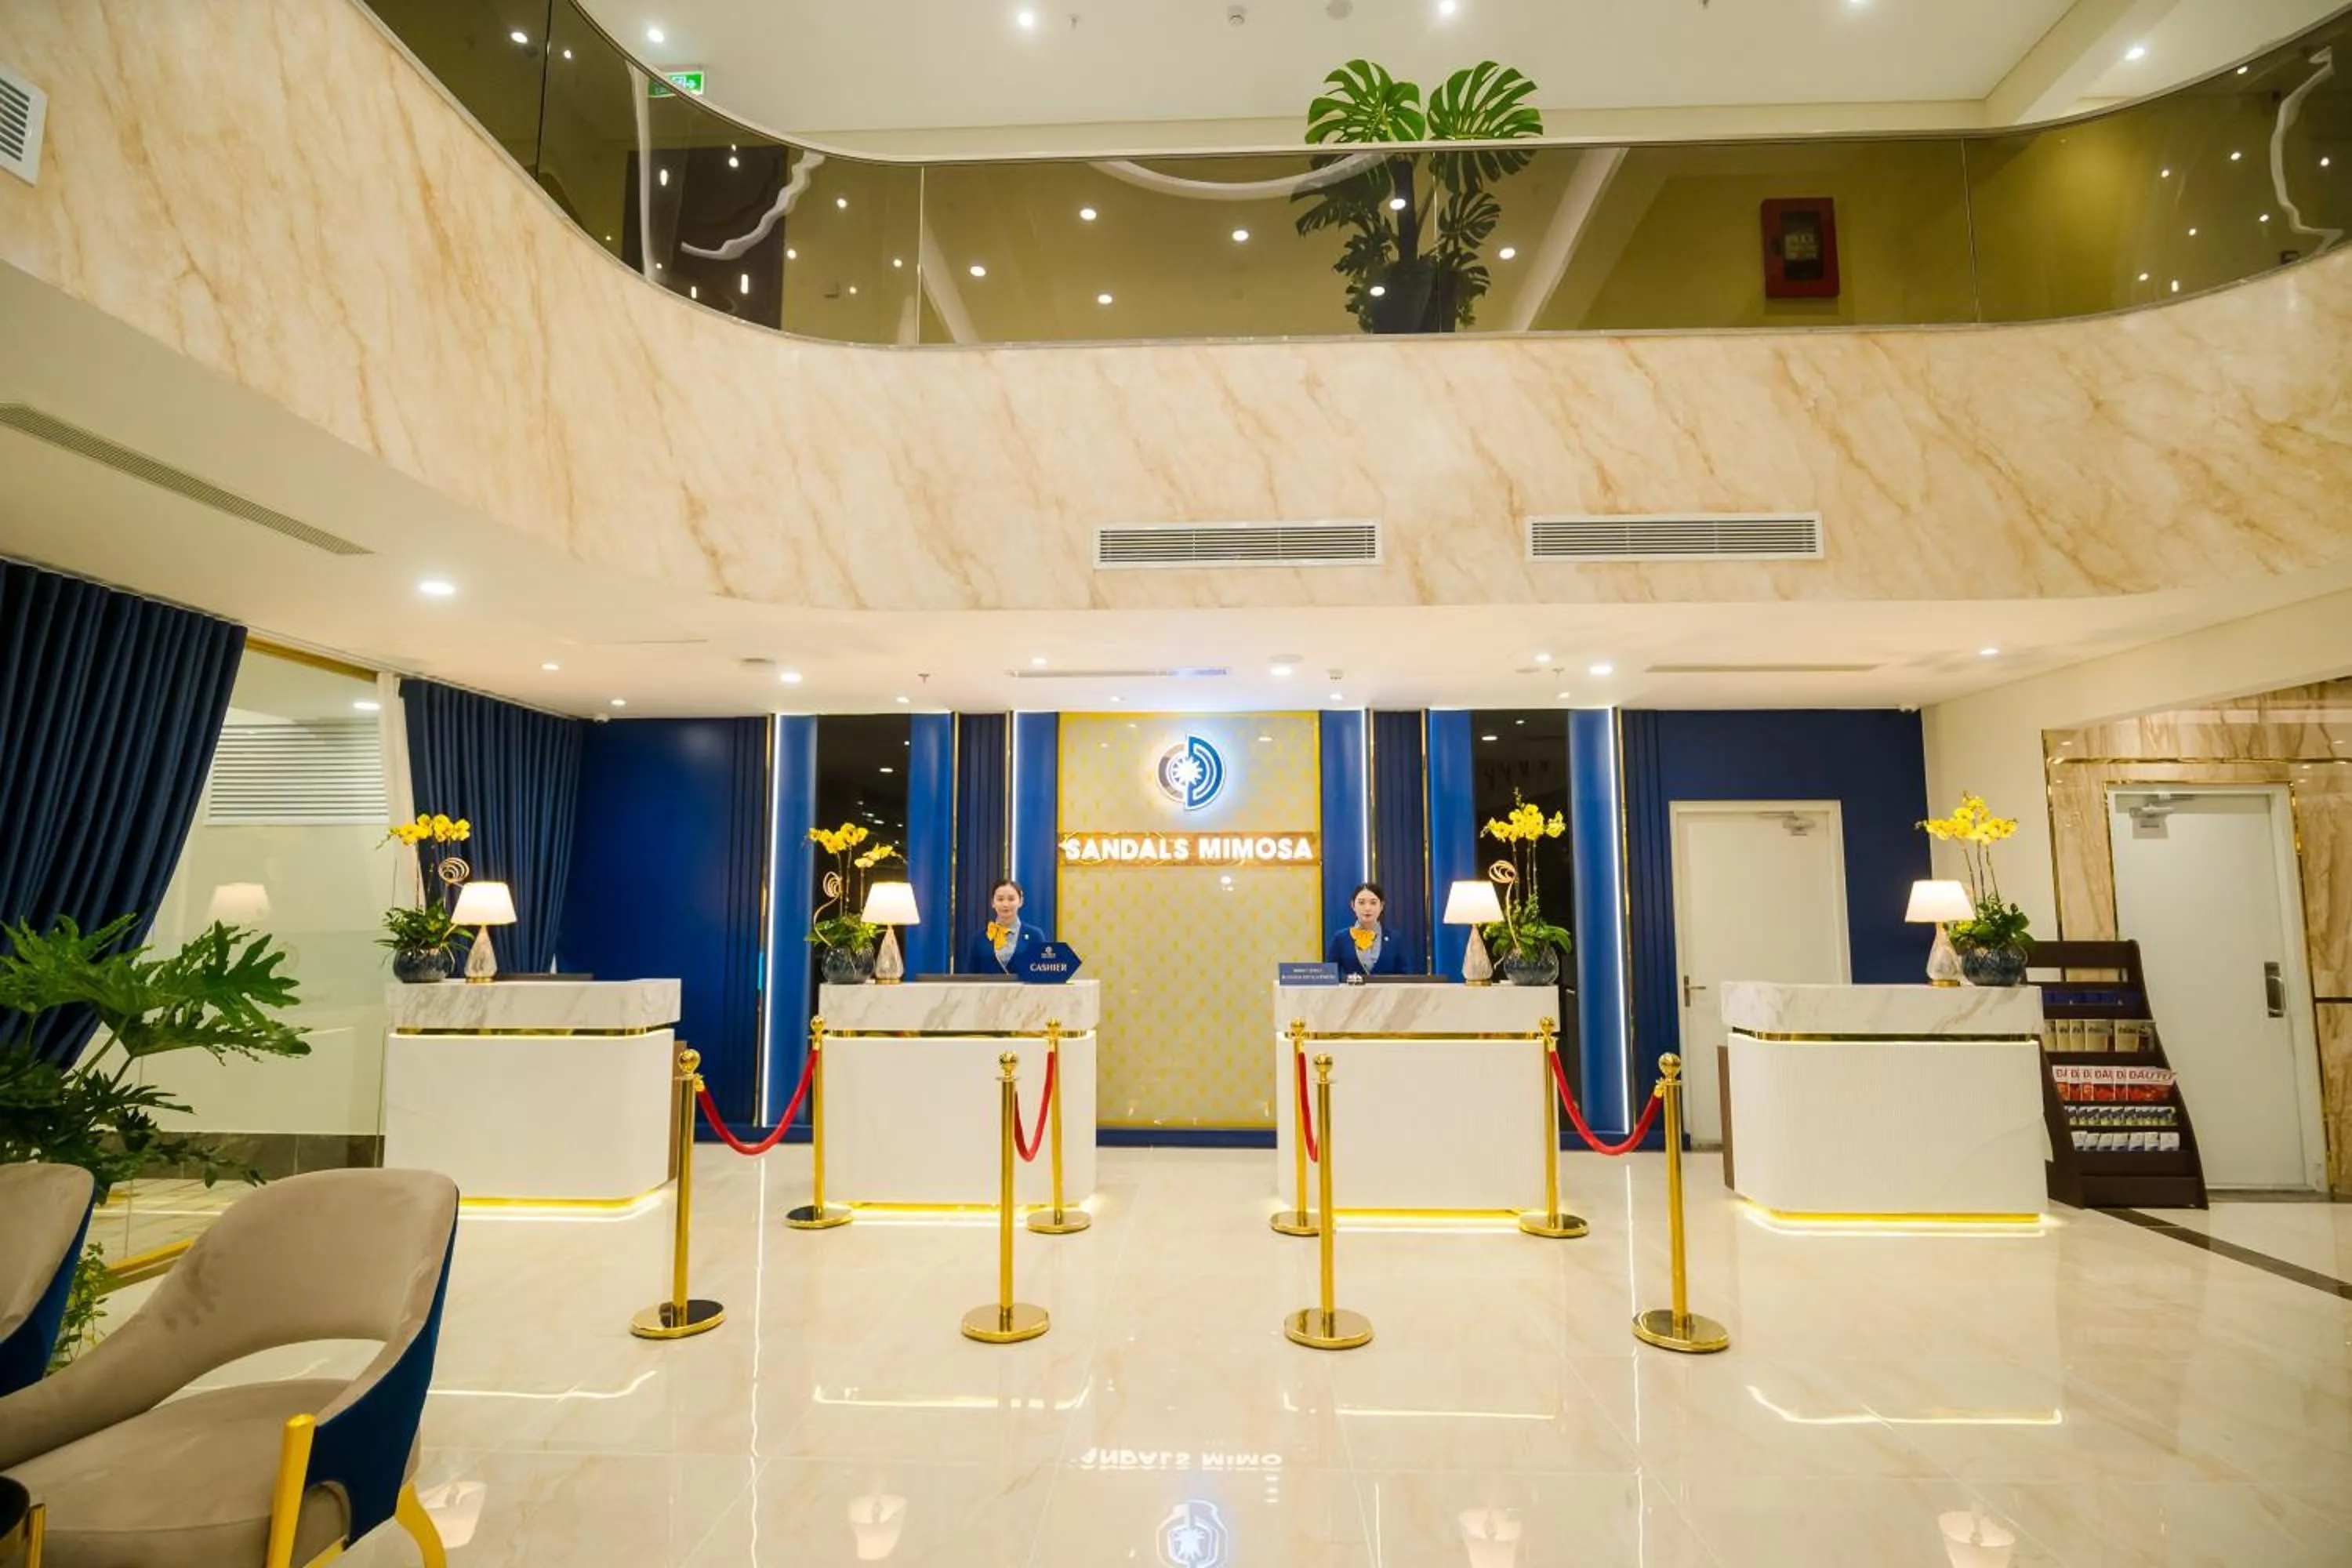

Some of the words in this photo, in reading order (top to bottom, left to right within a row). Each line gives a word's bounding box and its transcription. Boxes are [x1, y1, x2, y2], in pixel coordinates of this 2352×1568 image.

[1065, 837, 1189, 860] SANDALS
[1198, 837, 1313, 859] MIMOSA
[1029, 963, 1067, 972] CASHIER
